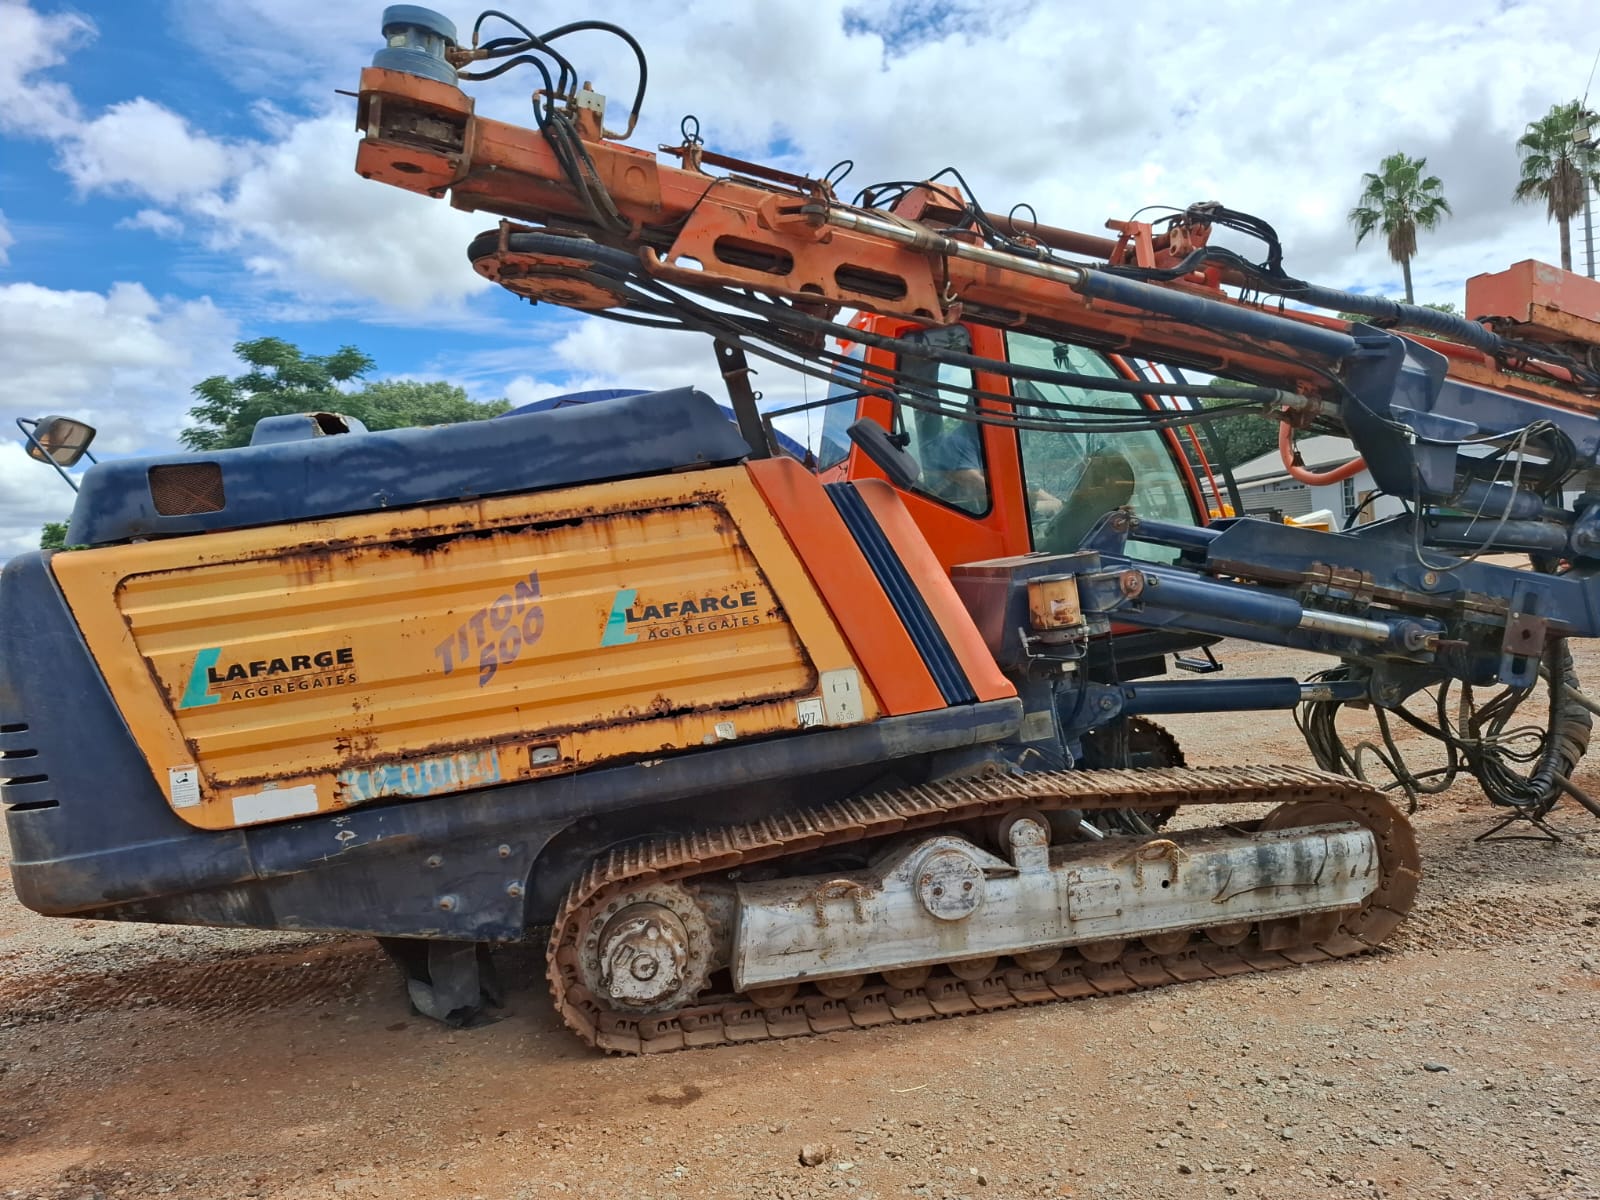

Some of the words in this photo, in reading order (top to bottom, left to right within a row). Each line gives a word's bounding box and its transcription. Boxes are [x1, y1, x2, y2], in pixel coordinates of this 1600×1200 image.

[433, 568, 541, 676] TITON
[625, 590, 758, 623] LAFARGE
[648, 614, 760, 640] AGGREGATES
[478, 605, 545, 688] 500
[208, 647, 354, 684] LAFARGE
[231, 673, 357, 701] AGGREGATES
